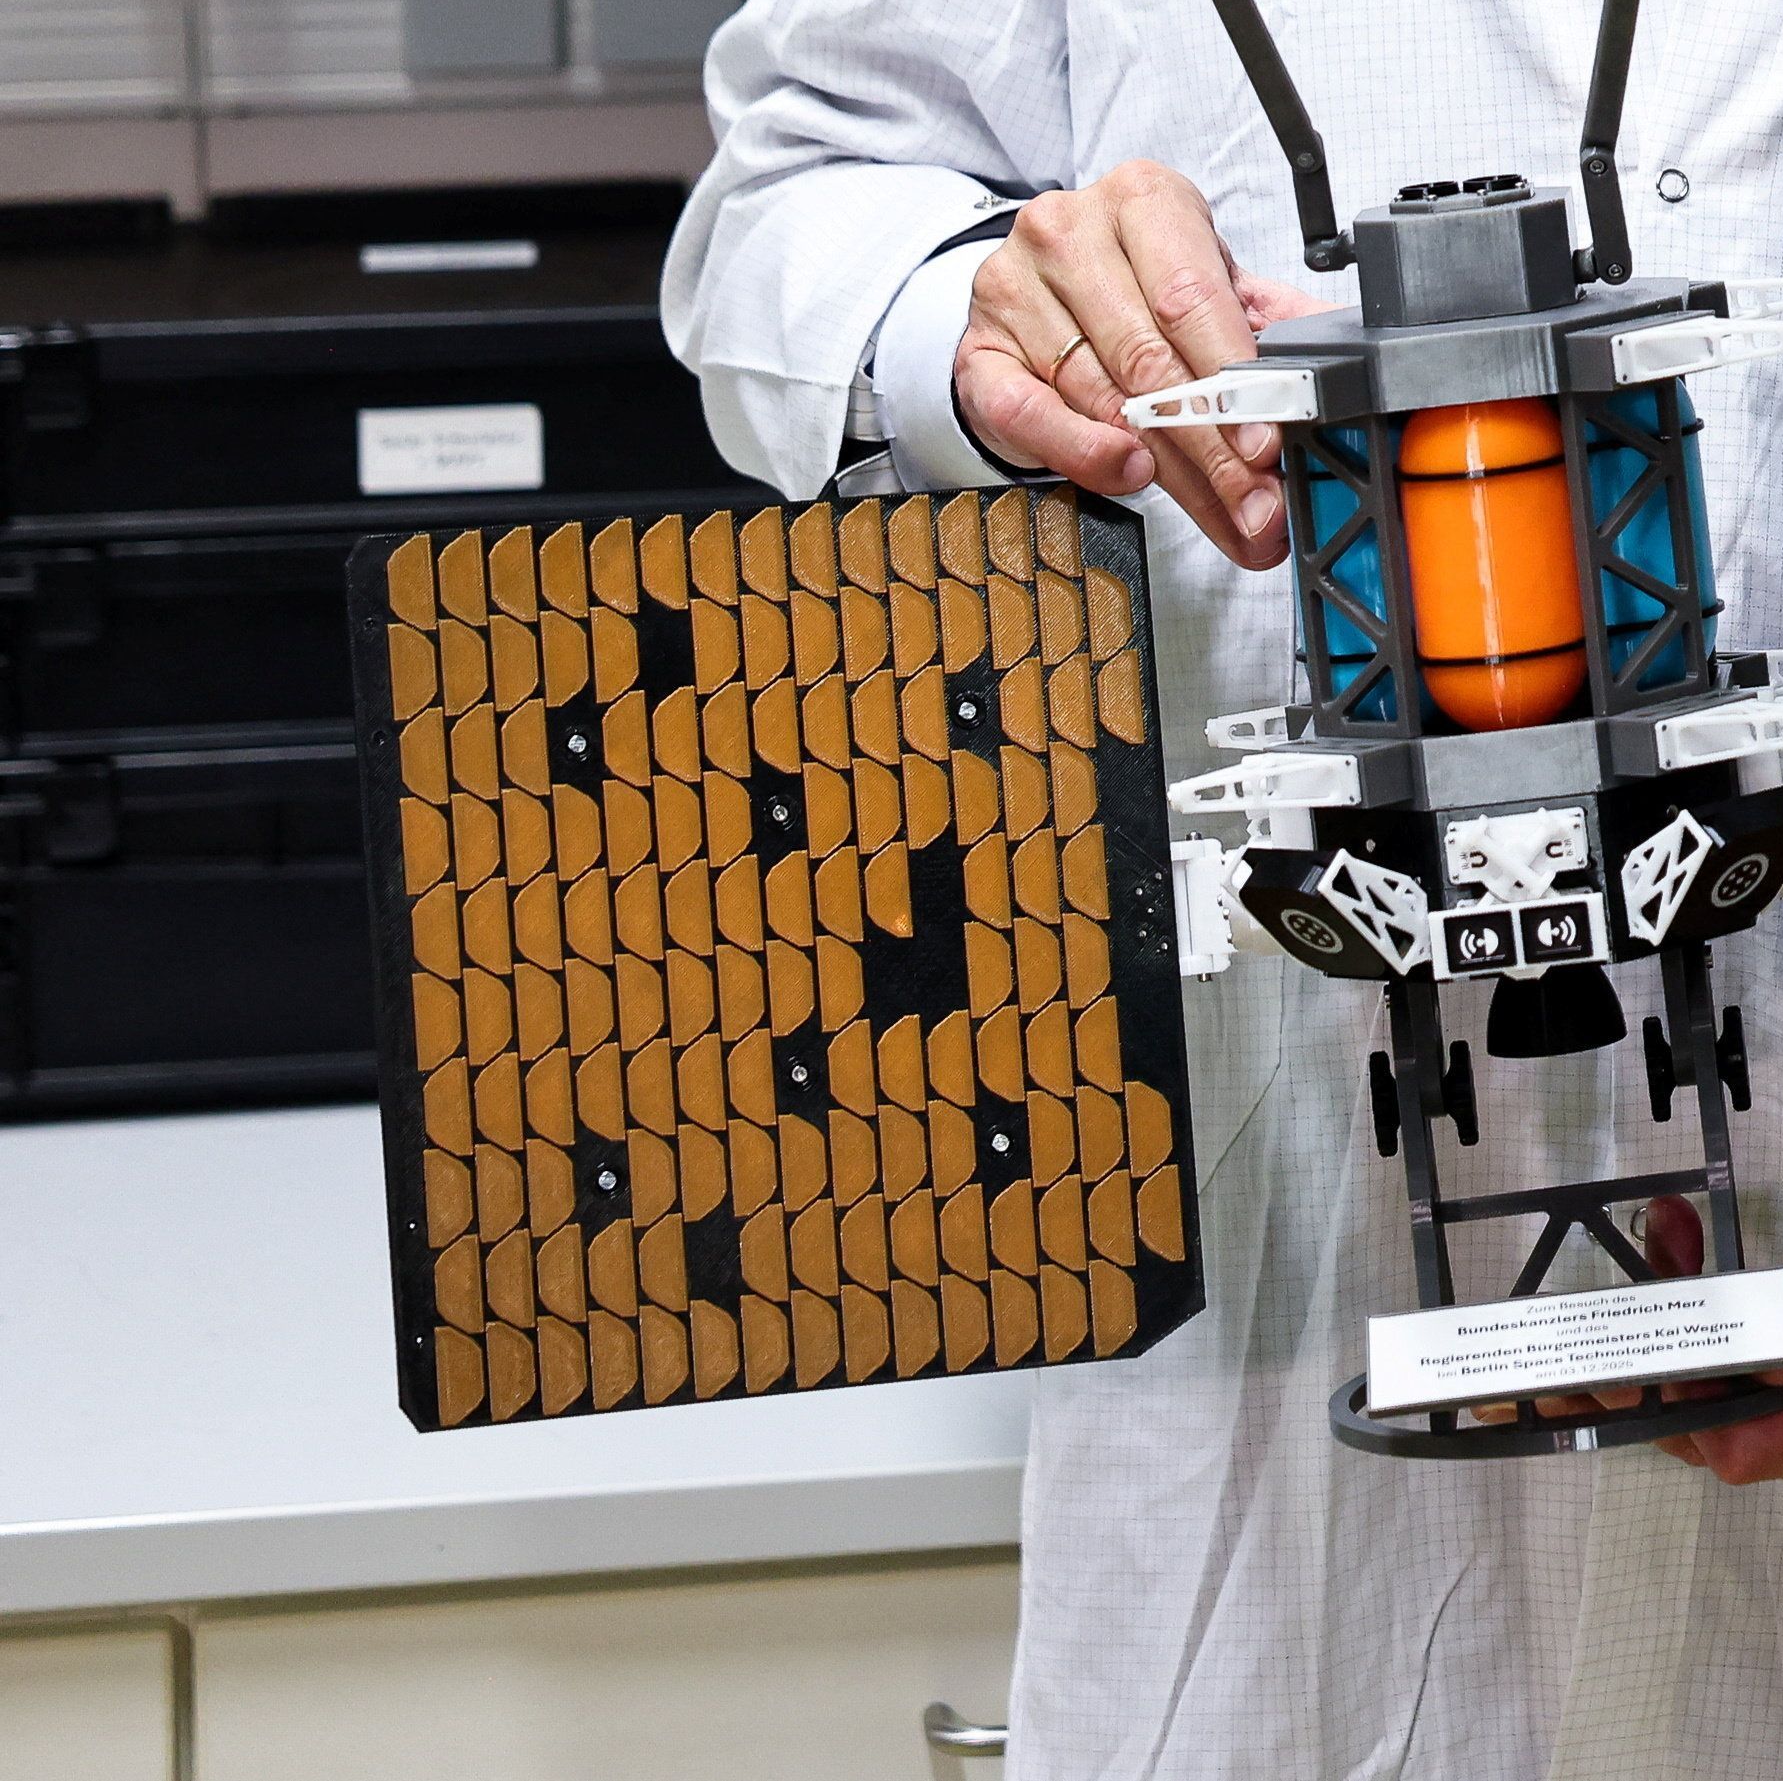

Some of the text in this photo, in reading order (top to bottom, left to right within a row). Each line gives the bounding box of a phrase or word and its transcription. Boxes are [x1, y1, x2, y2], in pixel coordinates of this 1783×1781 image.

[1457, 1298, 1706, 1336] Bundeskanzlers Friedrich Merz
[1420, 1346, 1523, 1367] Regierenden
[1655, 1327, 1680, 1338] Kai
[1683, 1320, 1745, 1335] Wegner
[1461, 1362, 1509, 1376] Berlin
[1513, 1356, 1564, 1371] Space
[1567, 1341, 1674, 1363] Technologies
[1678, 1335, 1730, 1350] GmbH
